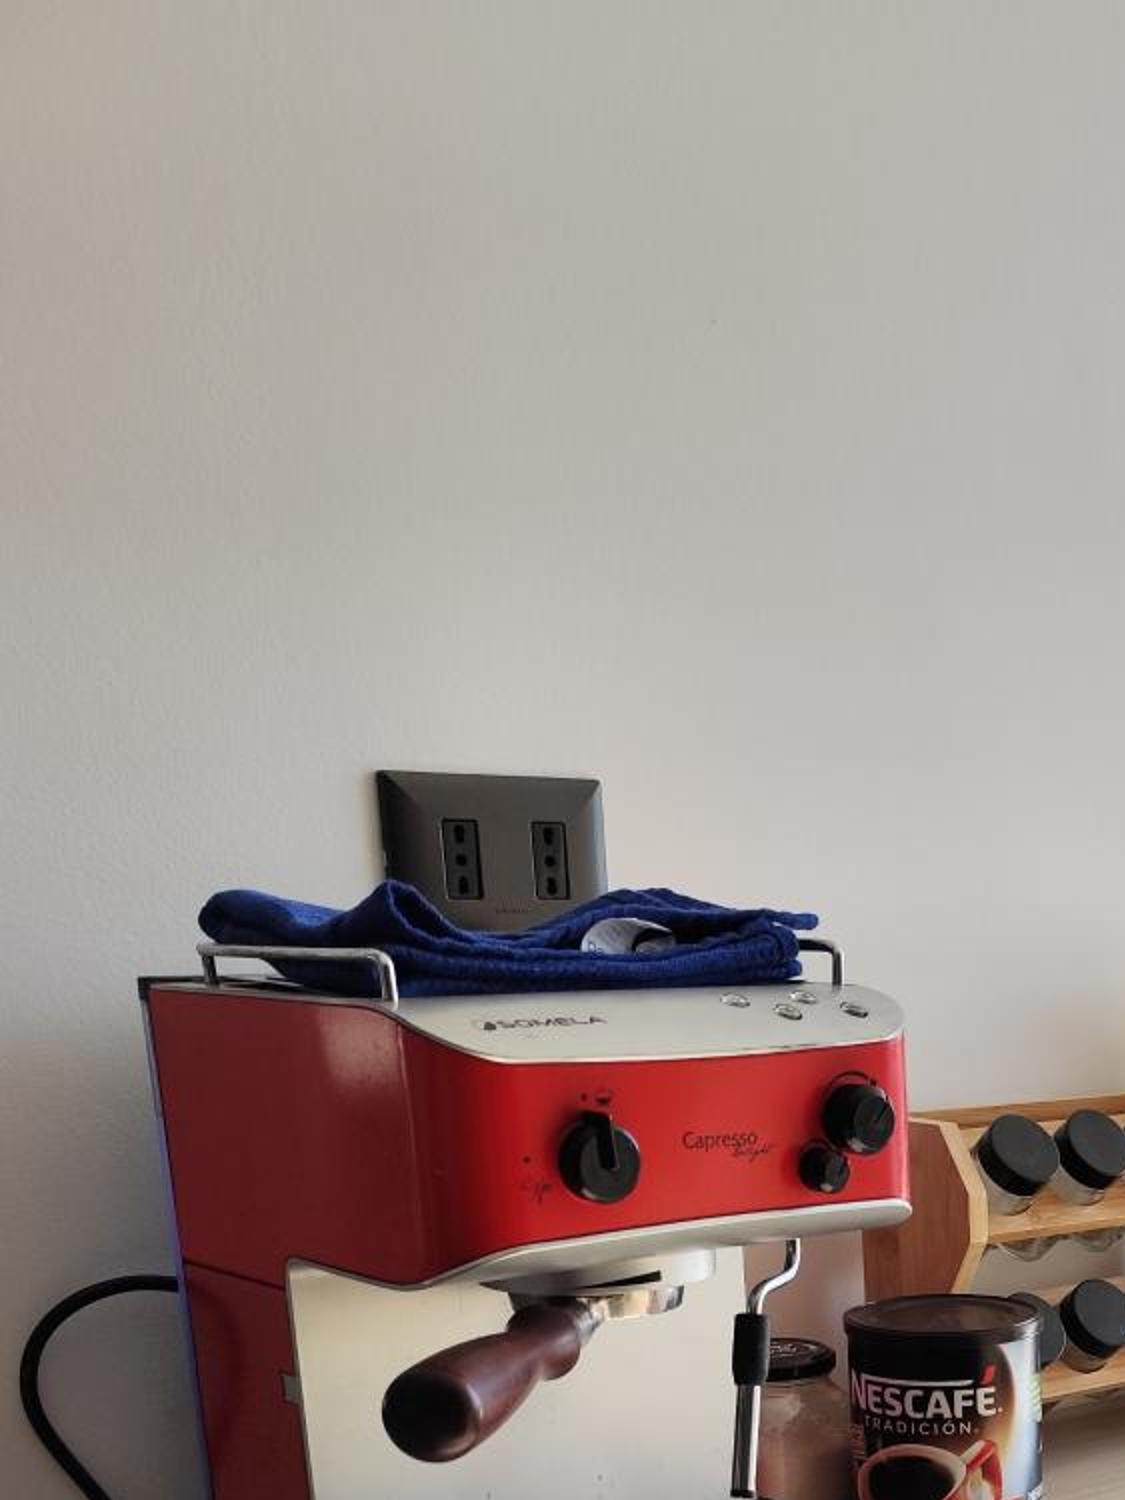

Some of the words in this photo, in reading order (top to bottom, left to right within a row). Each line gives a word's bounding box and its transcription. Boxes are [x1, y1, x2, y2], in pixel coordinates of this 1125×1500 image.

[496, 1015, 608, 1029] SOMELA
[682, 1131, 757, 1153] Capresso
[851, 1365, 997, 1420] NESCAFÉ
[864, 1415, 972, 1436] TRADICIÓN
